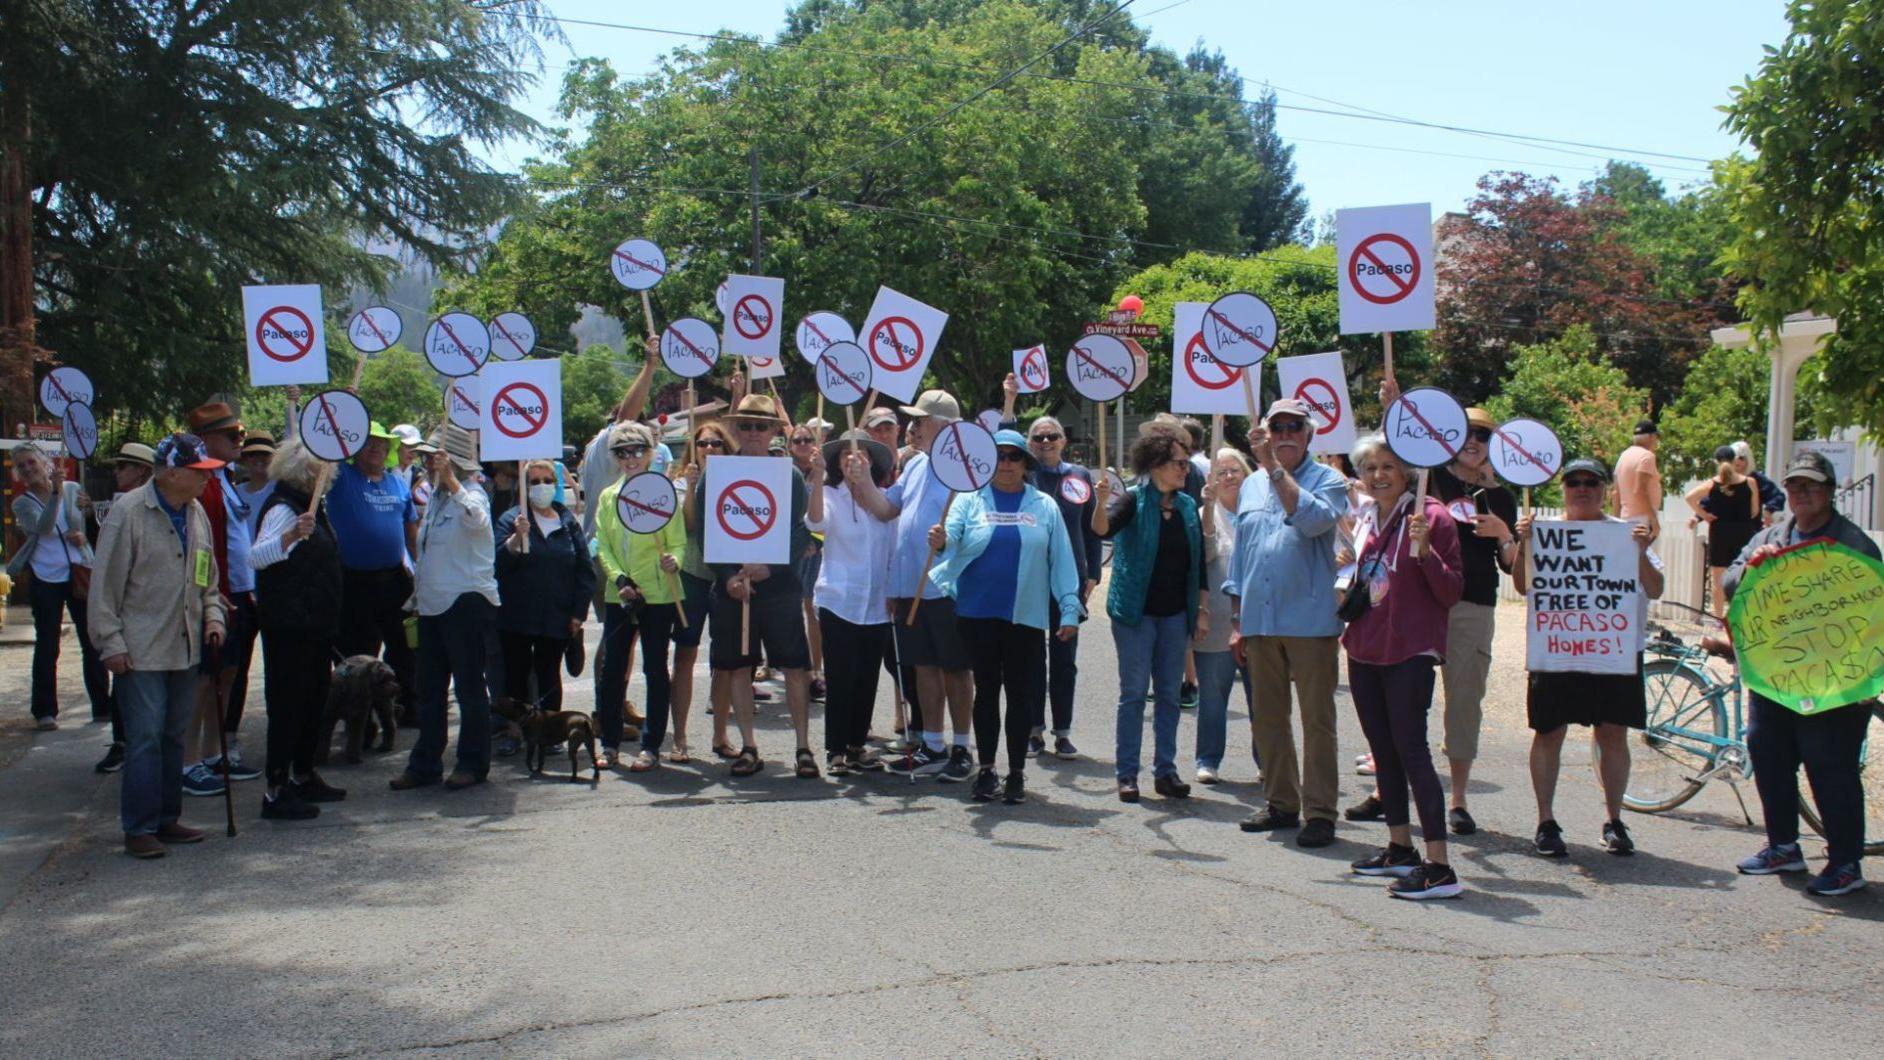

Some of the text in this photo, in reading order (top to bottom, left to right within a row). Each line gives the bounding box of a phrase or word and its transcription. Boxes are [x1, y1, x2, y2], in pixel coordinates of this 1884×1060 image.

[1356, 263, 1414, 276] Pacaso
[738, 311, 769, 323] Pacaso
[262, 328, 309, 340] Pacaso
[1095, 324, 1130, 336] Vineyard
[876, 331, 917, 357] Pacaso
[1191, 352, 1215, 364] Pac
[497, 405, 543, 416] Pacaso
[1306, 401, 1336, 412] acaso
[1396, 400, 1460, 442] PACASO
[722, 503, 771, 516] Pacaso
[1536, 527, 1586, 551] WE
[1533, 553, 1605, 573] WANT
[1532, 575, 1636, 593] OUR TOWN
[1534, 592, 1623, 611] FREE OF
[1770, 585, 1884, 629] NEIGHBORHOO
[1536, 612, 1628, 632] PACASO
[1772, 616, 1870, 663] STOP
